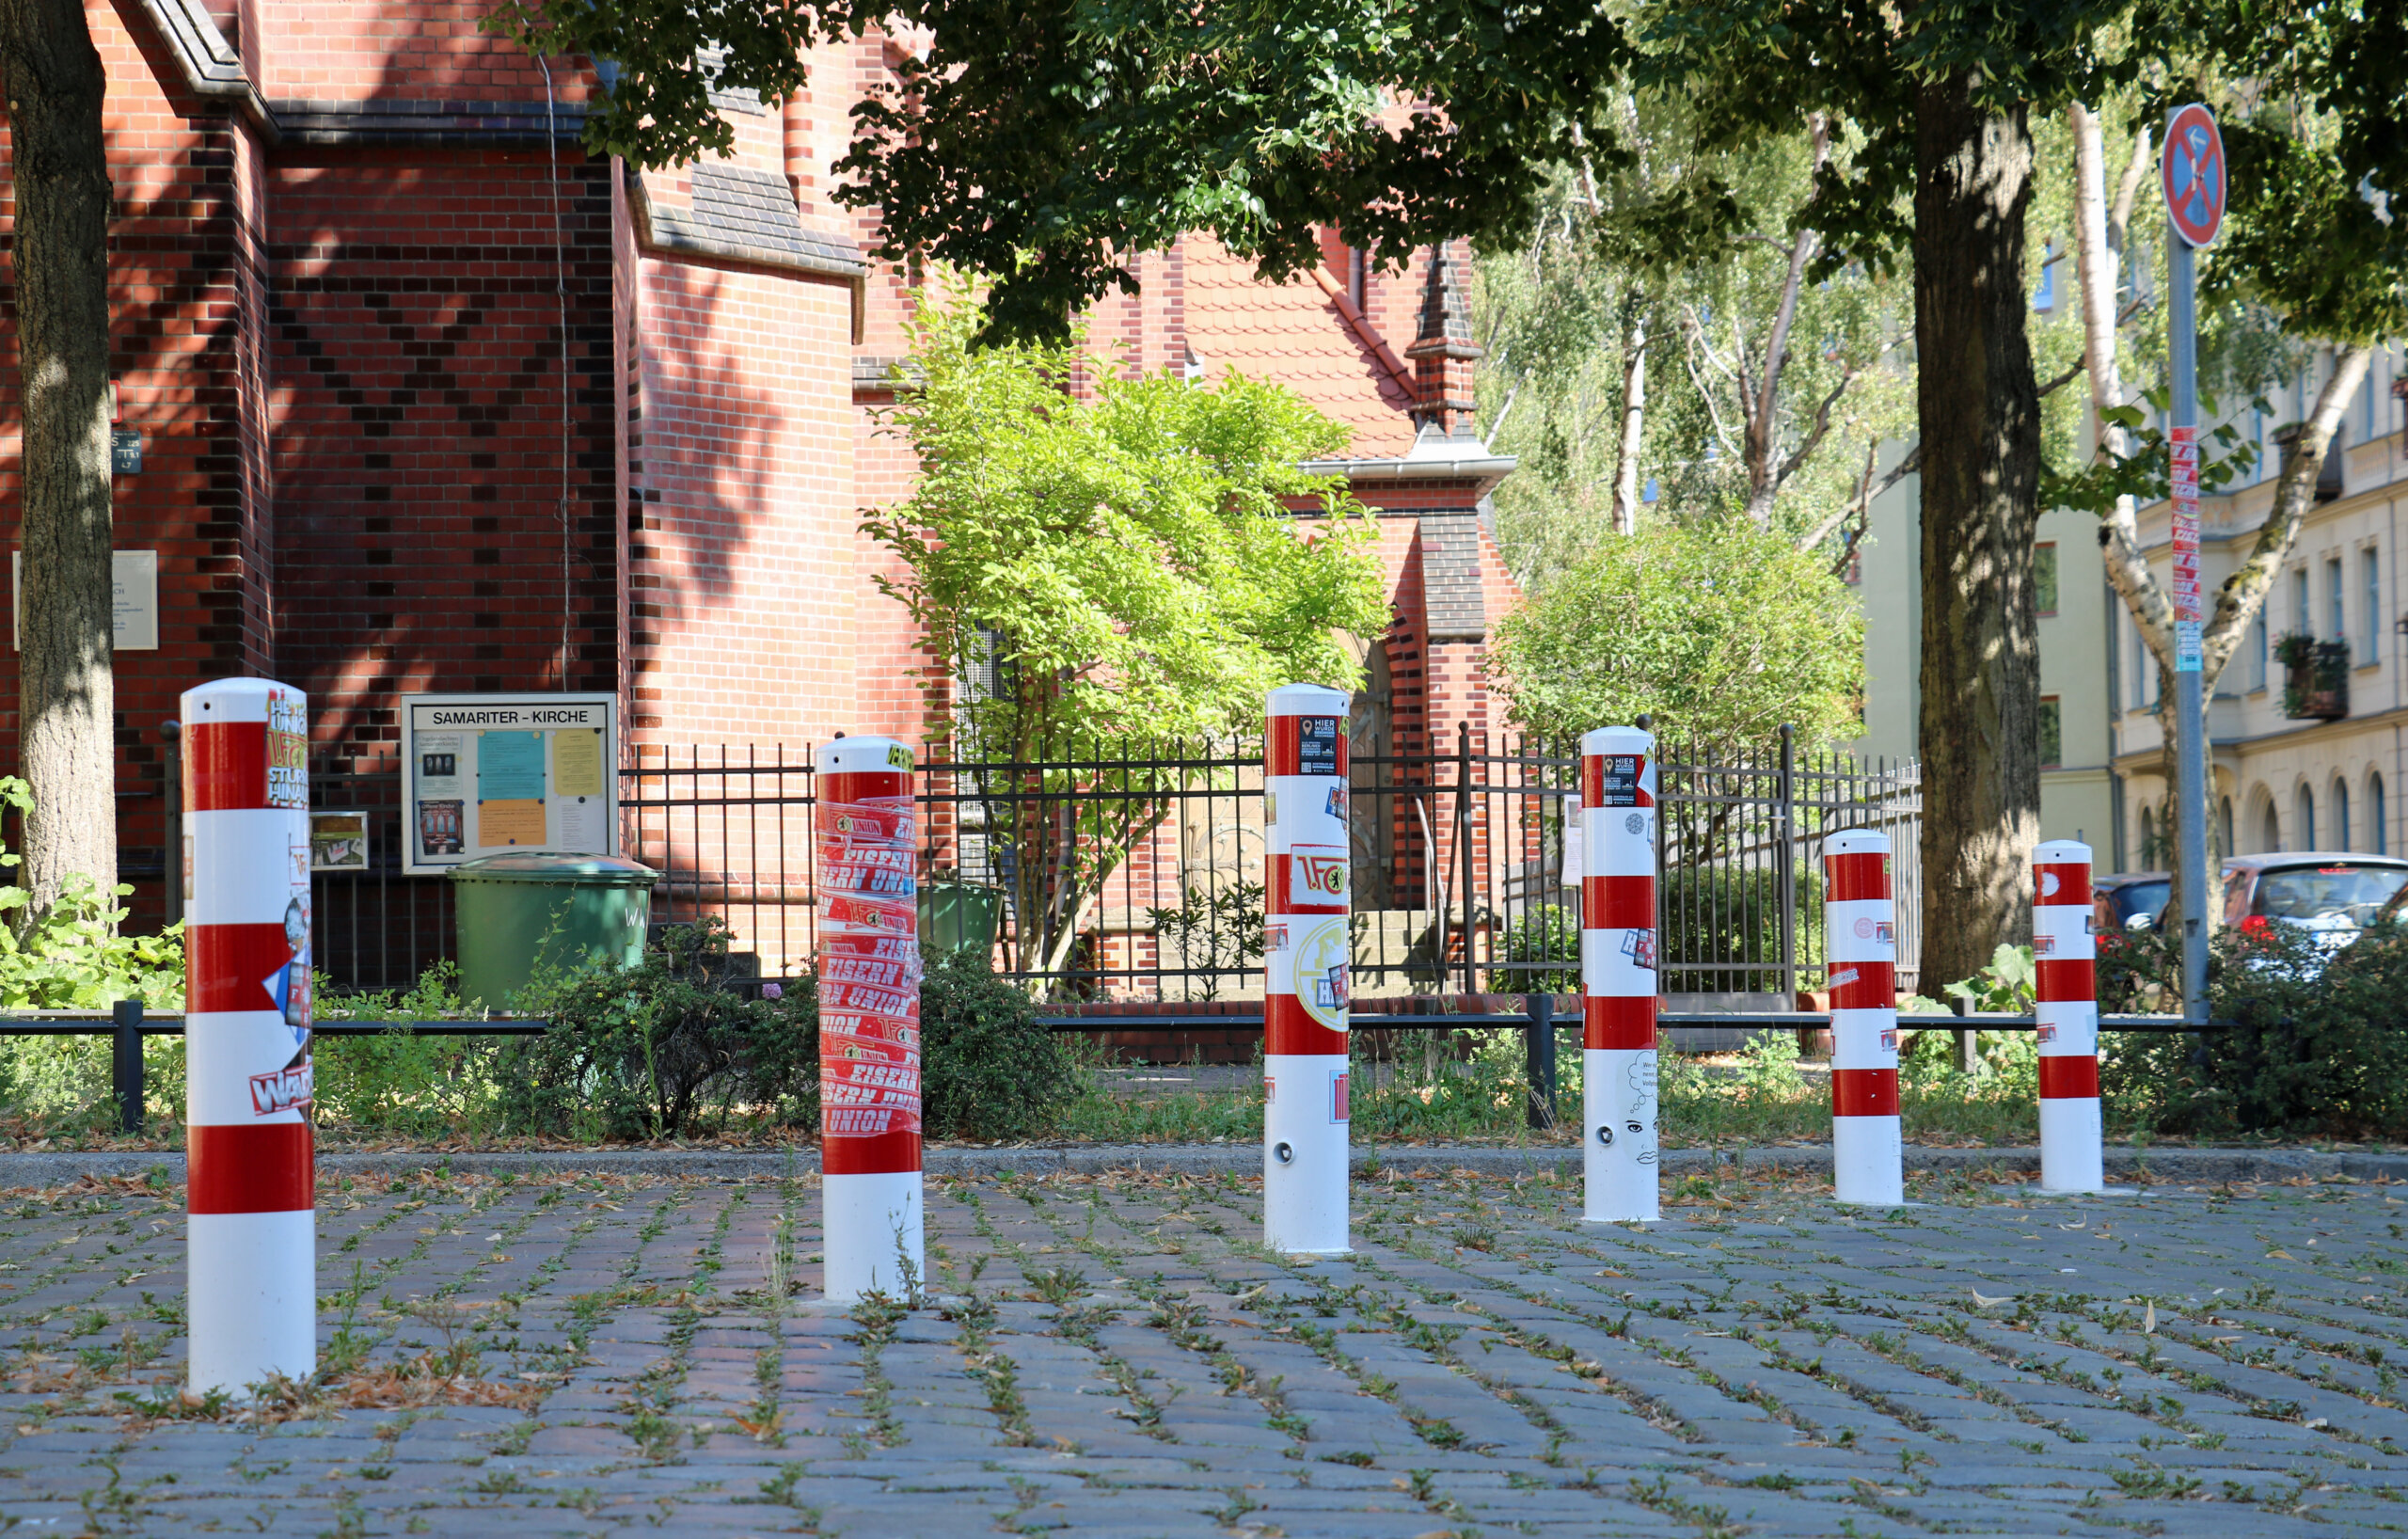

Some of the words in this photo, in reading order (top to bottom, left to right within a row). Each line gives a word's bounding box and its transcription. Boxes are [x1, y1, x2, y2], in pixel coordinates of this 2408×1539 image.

[433, 712, 518, 724] SAMARITER
[532, 710, 589, 723] KIRCHE
[1314, 719, 1335, 727] HIER
[852, 818, 881, 836] UNION
[826, 958, 900, 986] EISERN
[848, 985, 911, 1017] UNION
[850, 1064, 919, 1091] EISERN
[830, 1110, 893, 1132] UNION
